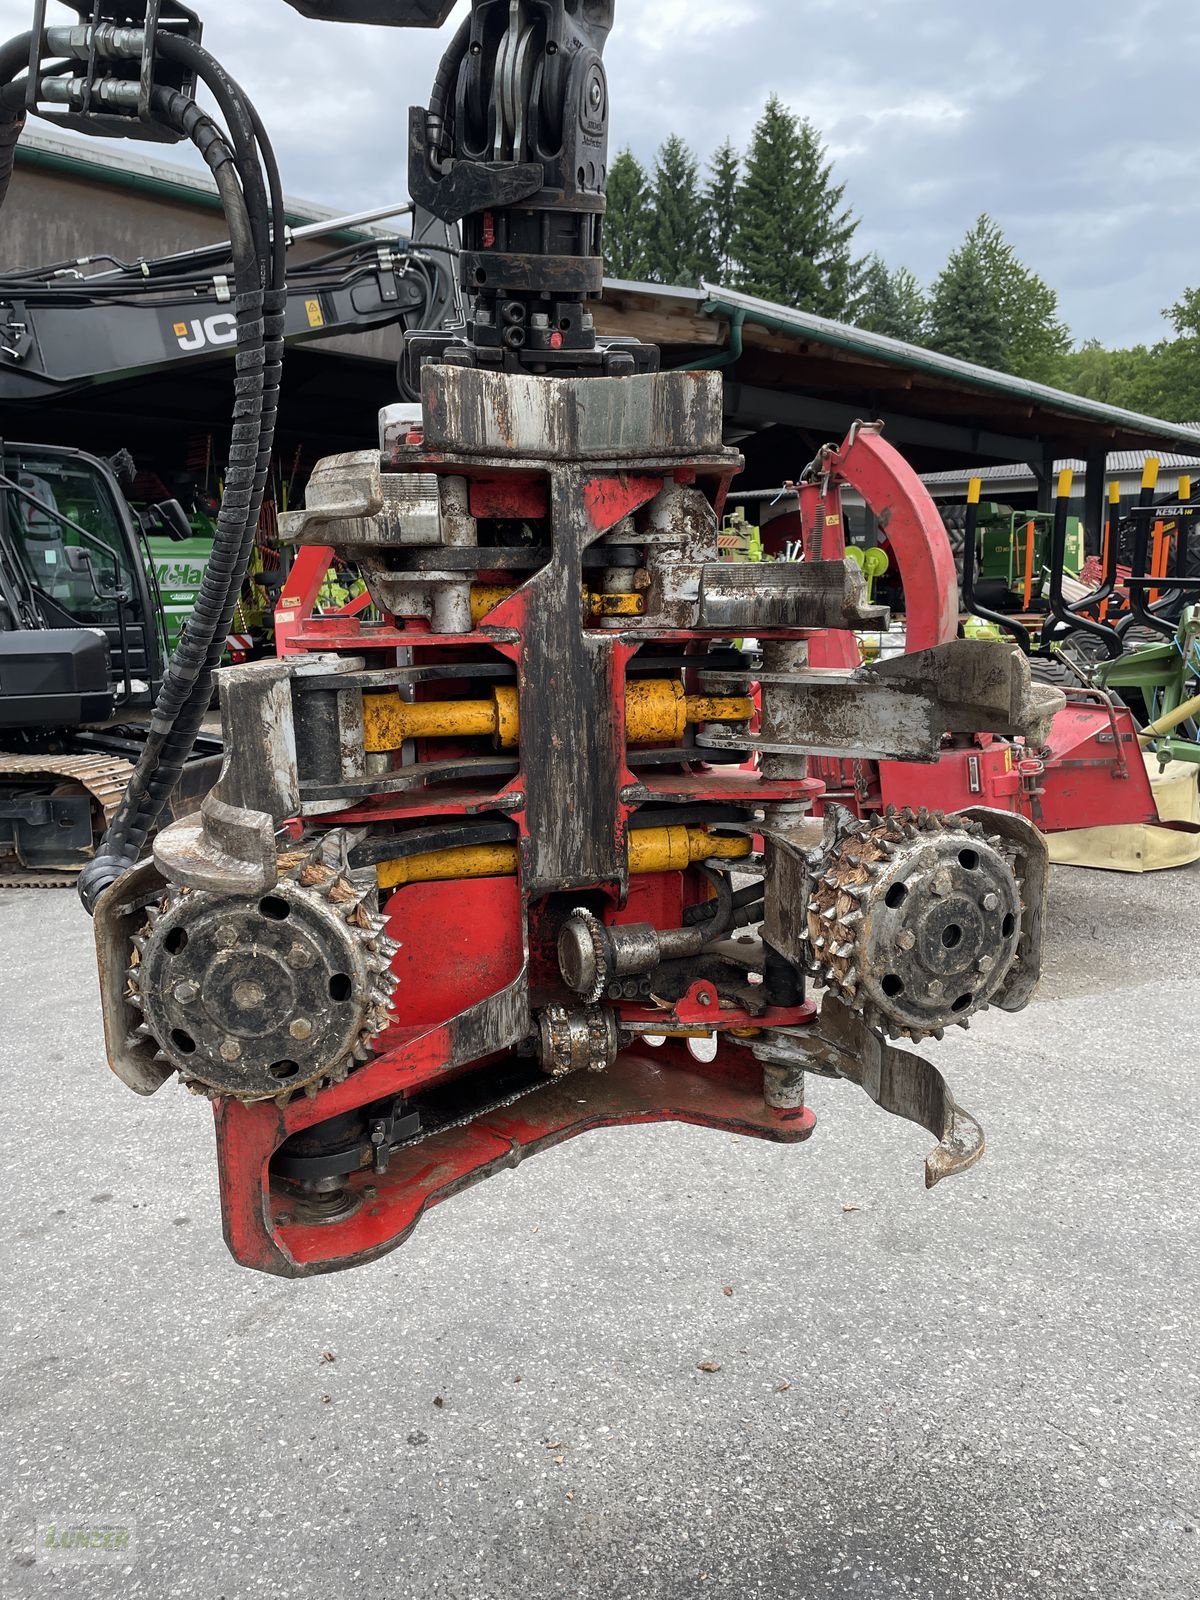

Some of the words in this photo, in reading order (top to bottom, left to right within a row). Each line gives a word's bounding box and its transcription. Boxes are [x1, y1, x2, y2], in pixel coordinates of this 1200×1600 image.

[177, 312, 237, 351] JC
[1155, 508, 1183, 517] KESLA
[146, 563, 209, 585] McHal
